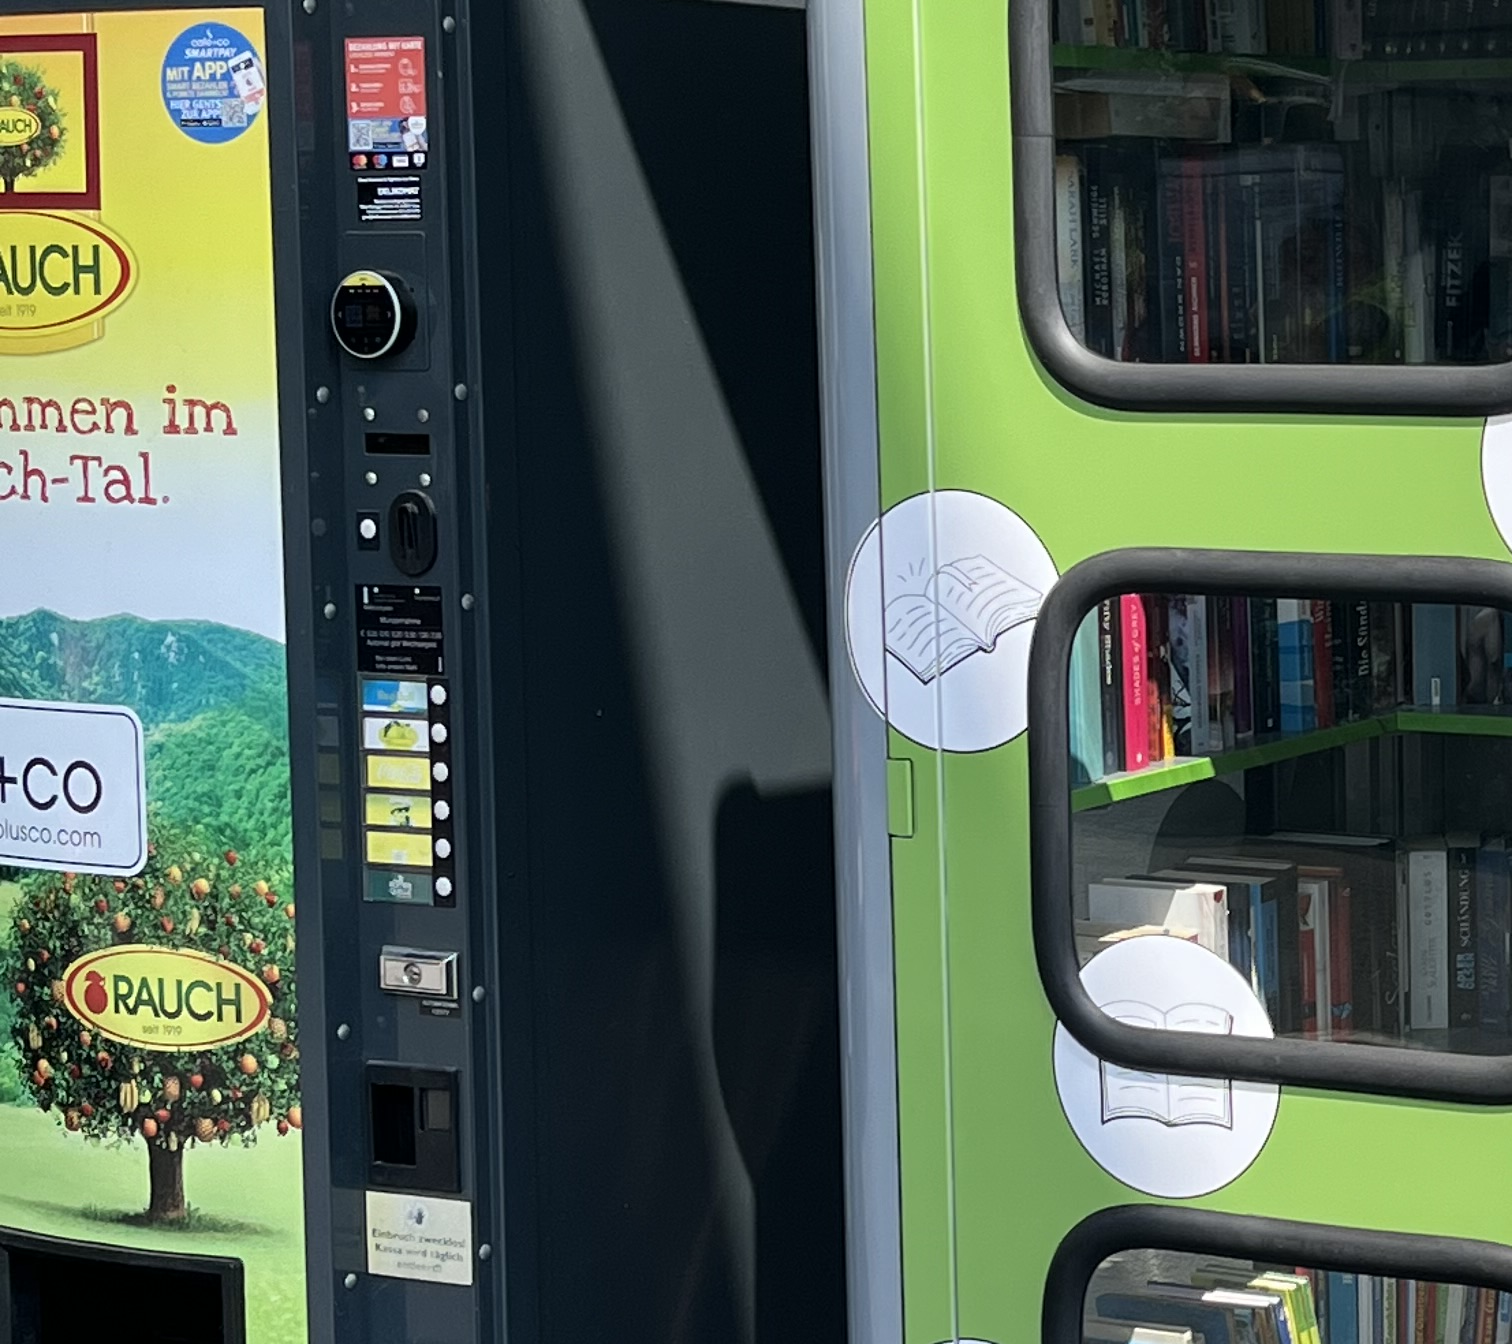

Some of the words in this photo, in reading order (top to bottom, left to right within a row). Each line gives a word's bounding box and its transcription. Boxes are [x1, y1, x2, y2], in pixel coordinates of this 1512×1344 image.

[166, 66, 190, 81] MIT
[192, 61, 227, 81] APP
[184, 47, 238, 59] SMARTPAY
[1445, 231, 1464, 309] FITZEK
[16, 303, 37, 317] 1919
[162, 384, 238, 436] im
[1130, 603, 1140, 639] GREY
[1131, 655, 1142, 706] SHADES
[1457, 869, 1470, 947] SCHÄNDUNG
[113, 974, 243, 1024] RAUCH
[372, 1228, 416, 1242] Einbruch
